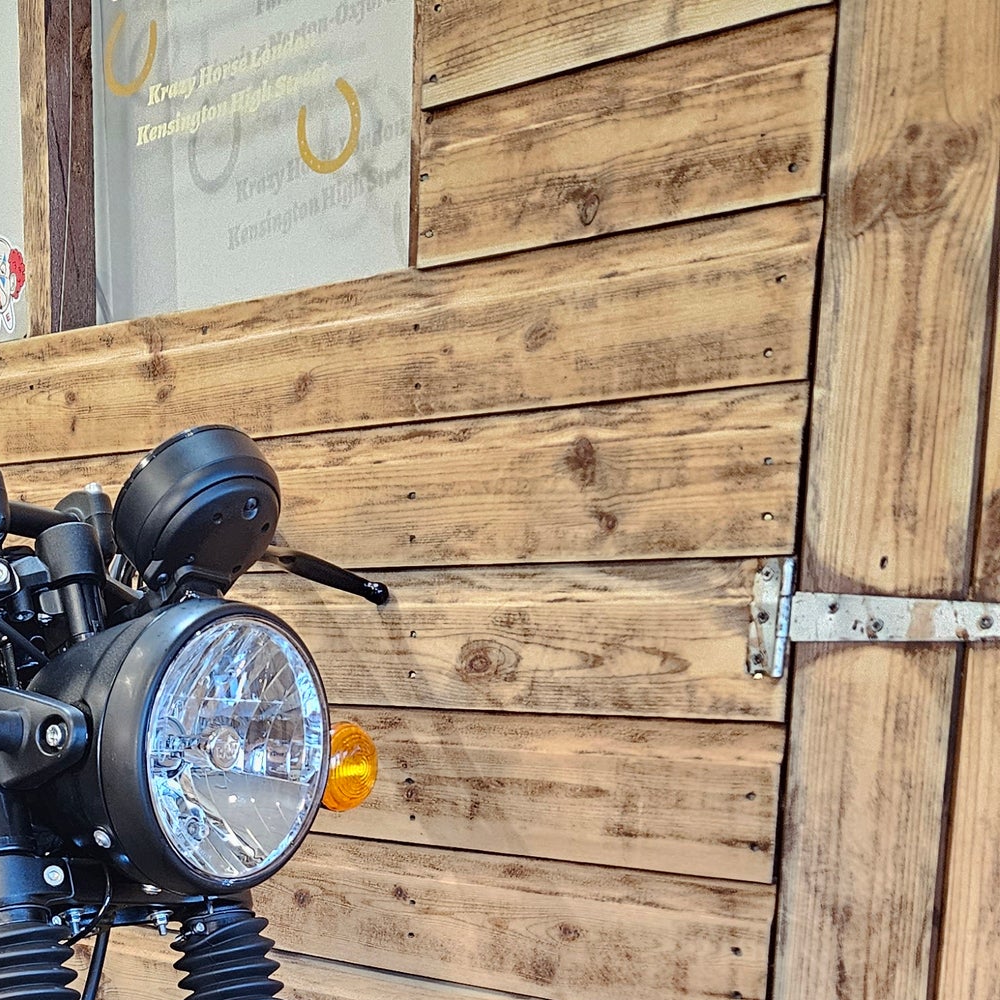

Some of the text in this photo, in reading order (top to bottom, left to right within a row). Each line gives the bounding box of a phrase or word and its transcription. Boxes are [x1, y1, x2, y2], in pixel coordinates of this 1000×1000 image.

[147, 76, 197, 106] Krazy
[199, 57, 248, 88] Horse
[136, 101, 228, 146] Kensington
[230, 79, 273, 113] High
